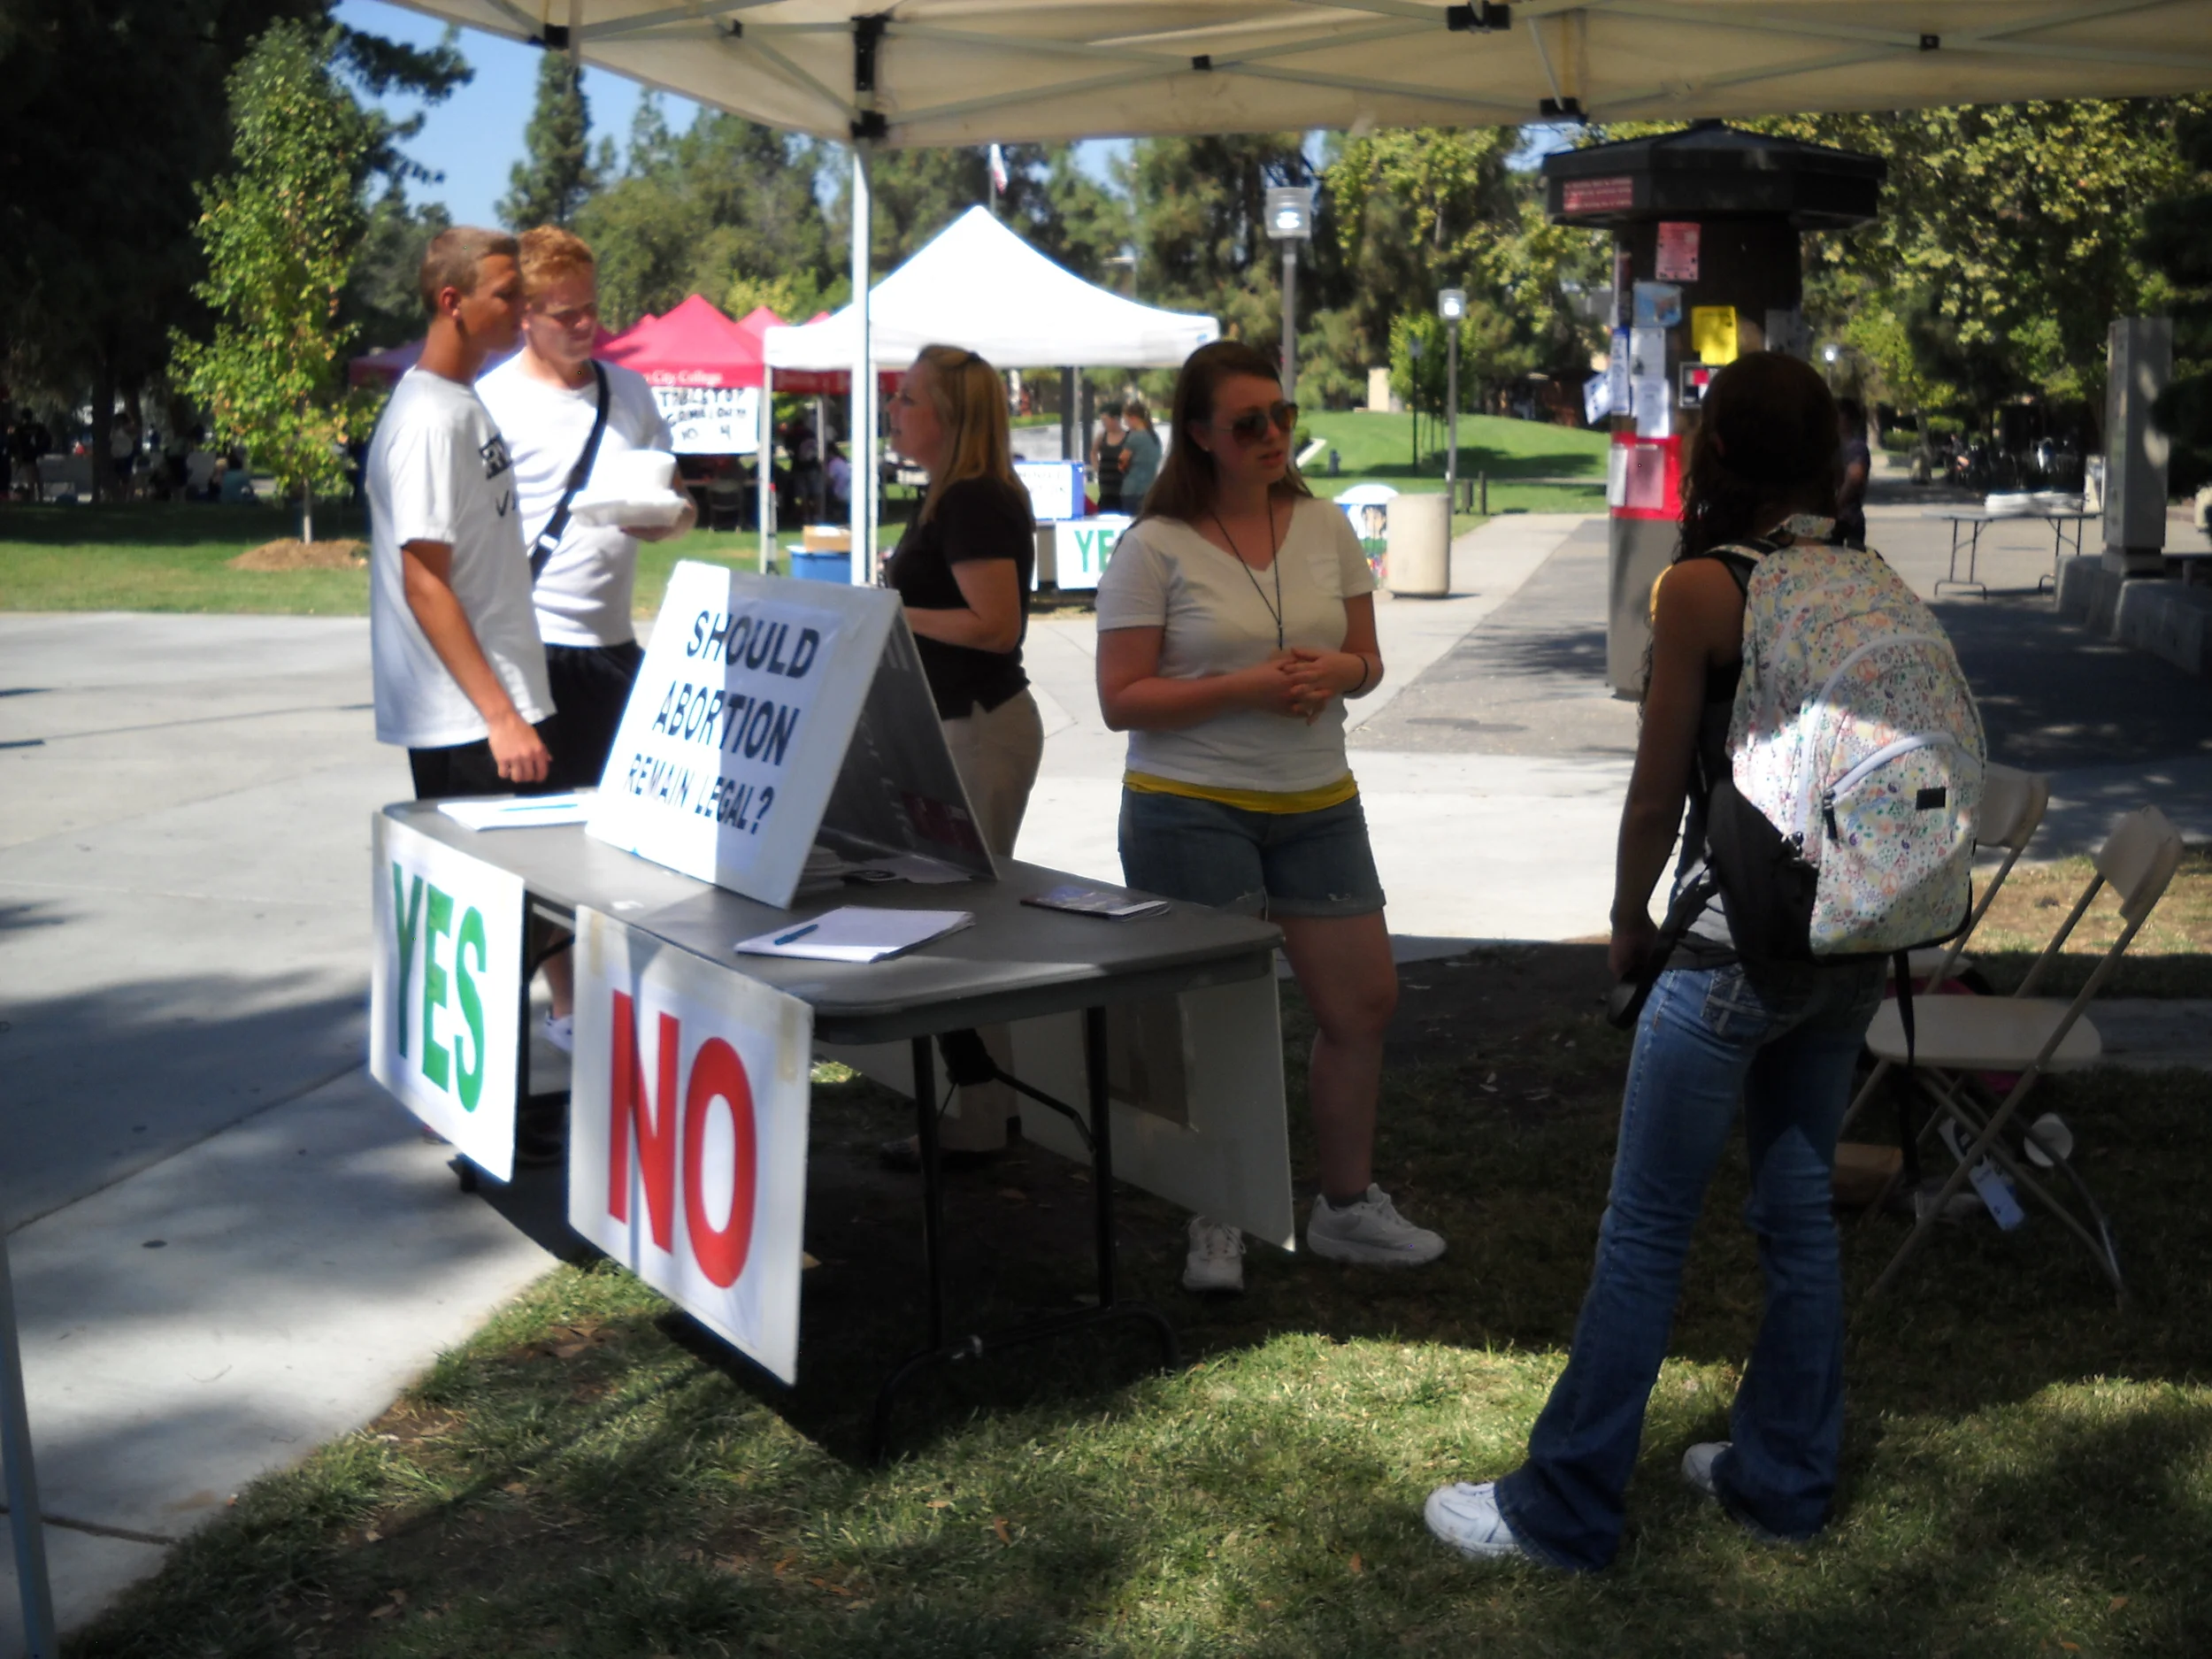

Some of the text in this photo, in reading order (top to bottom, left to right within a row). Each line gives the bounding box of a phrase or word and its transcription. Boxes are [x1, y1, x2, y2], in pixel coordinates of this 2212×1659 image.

[679, 370, 722, 387] College
[1074, 529, 1125, 572] YE
[687, 610, 820, 680] SHOULD
[652, 680, 801, 766] ABORTION
[625, 753, 775, 835] REMAIN LEGAL?
[392, 860, 488, 1113] YES
[608, 988, 758, 1289] NO
